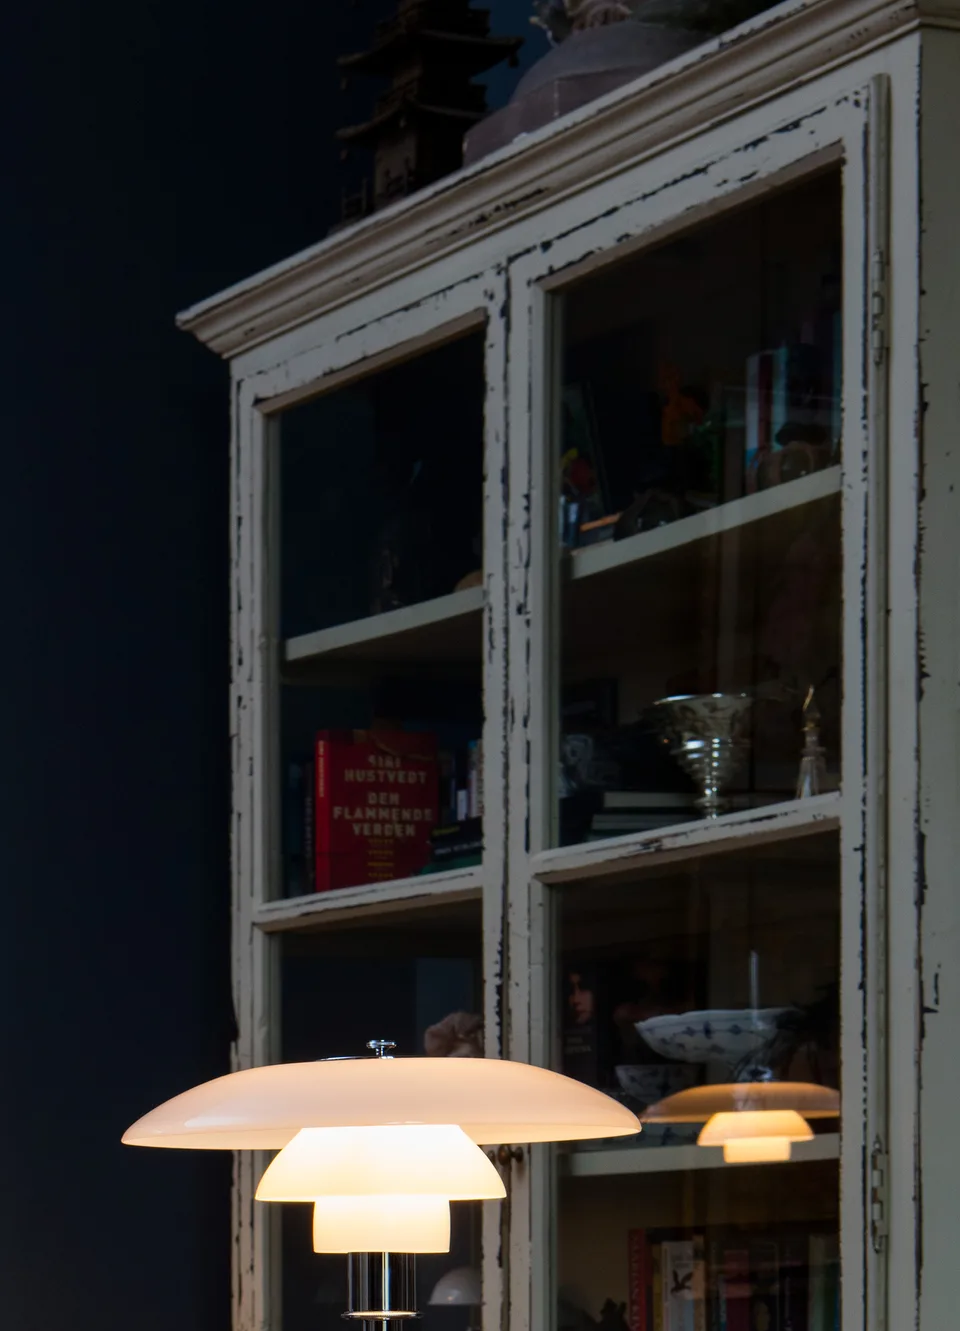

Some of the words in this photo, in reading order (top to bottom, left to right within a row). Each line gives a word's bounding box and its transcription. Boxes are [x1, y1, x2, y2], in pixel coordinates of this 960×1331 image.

[344, 769, 427, 784] HUSTVEDT
[367, 792, 400, 806] DEN
[333, 806, 433, 822] FLAMMENDE
[352, 823, 416, 838] VERDEN
